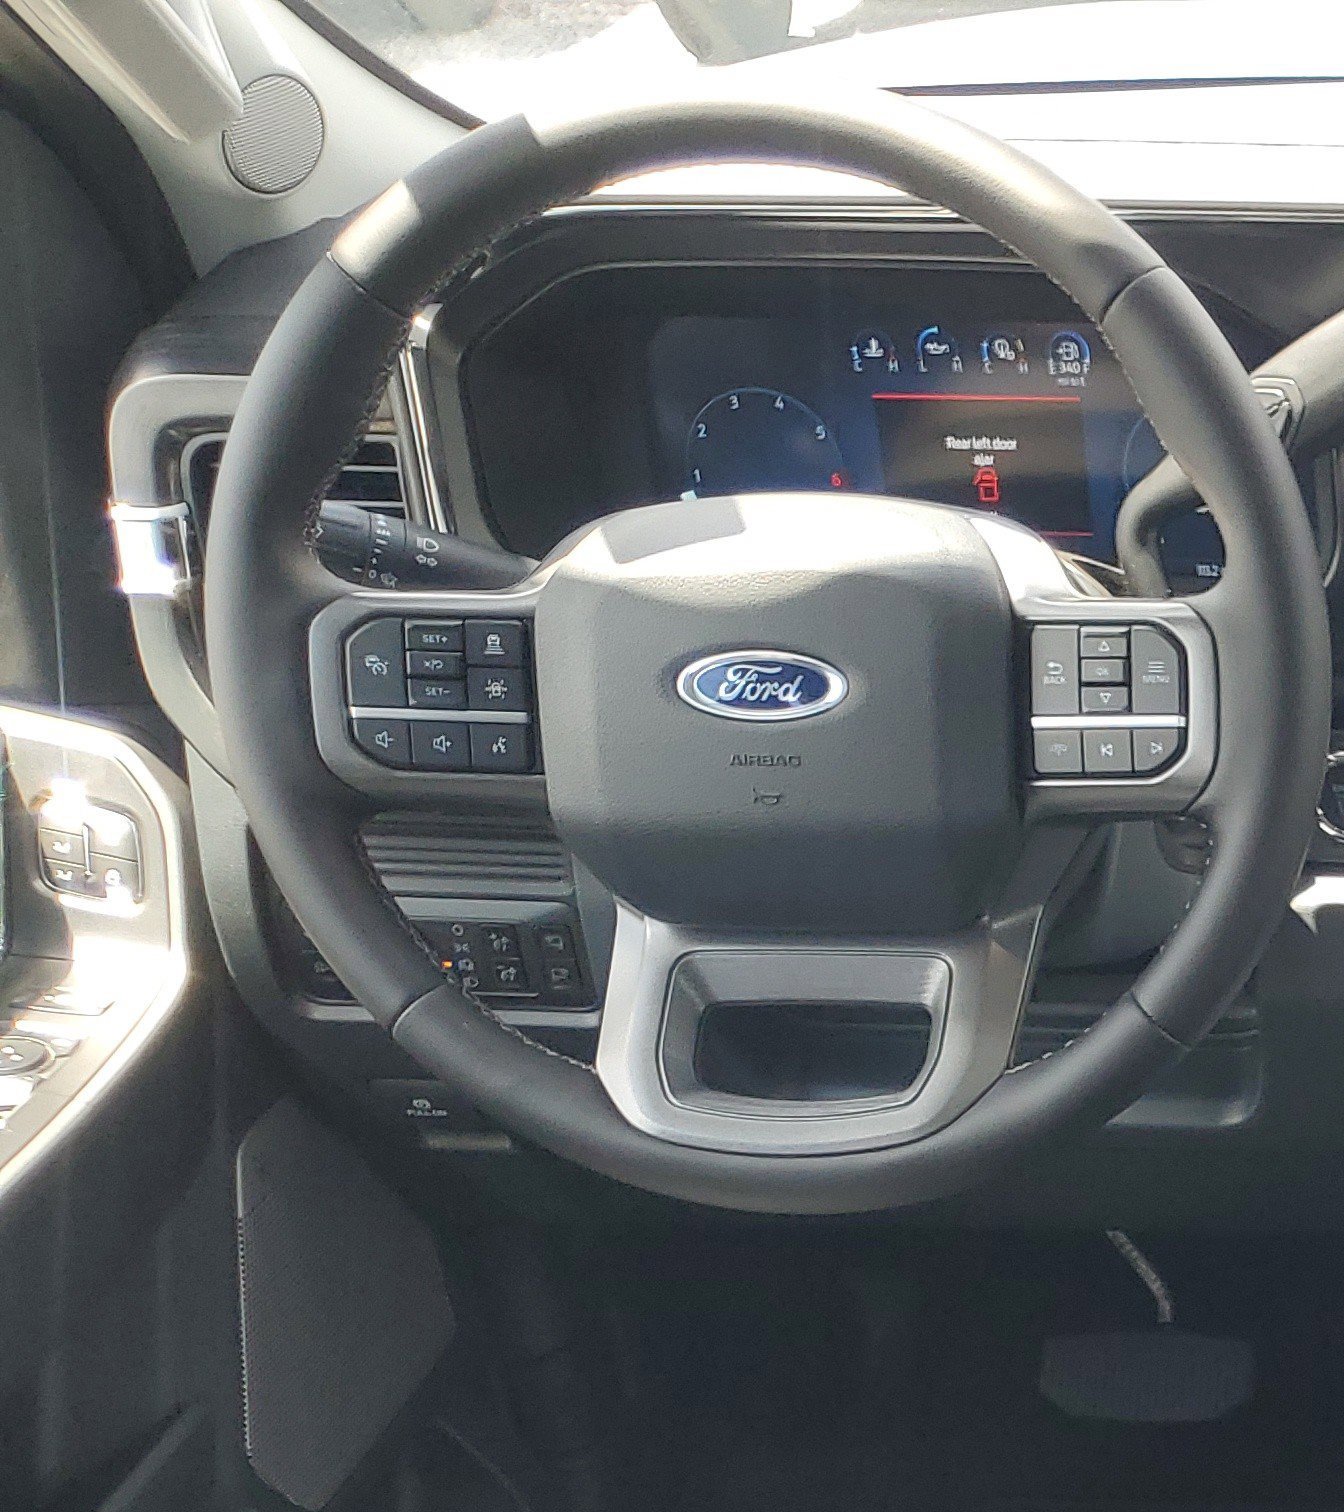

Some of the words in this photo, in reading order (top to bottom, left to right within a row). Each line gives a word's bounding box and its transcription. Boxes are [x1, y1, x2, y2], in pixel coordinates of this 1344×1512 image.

[729, 395, 739, 410] 3
[775, 396, 785, 411] 4
[697, 423, 707, 439] 2
[945, 436, 971, 450] Rear
[973, 436, 991, 450] left
[992, 436, 1017, 450] door
[831, 473, 842, 487] 6
[718, 664, 804, 702] Ford
[730, 754, 802, 768] AIRBAG
